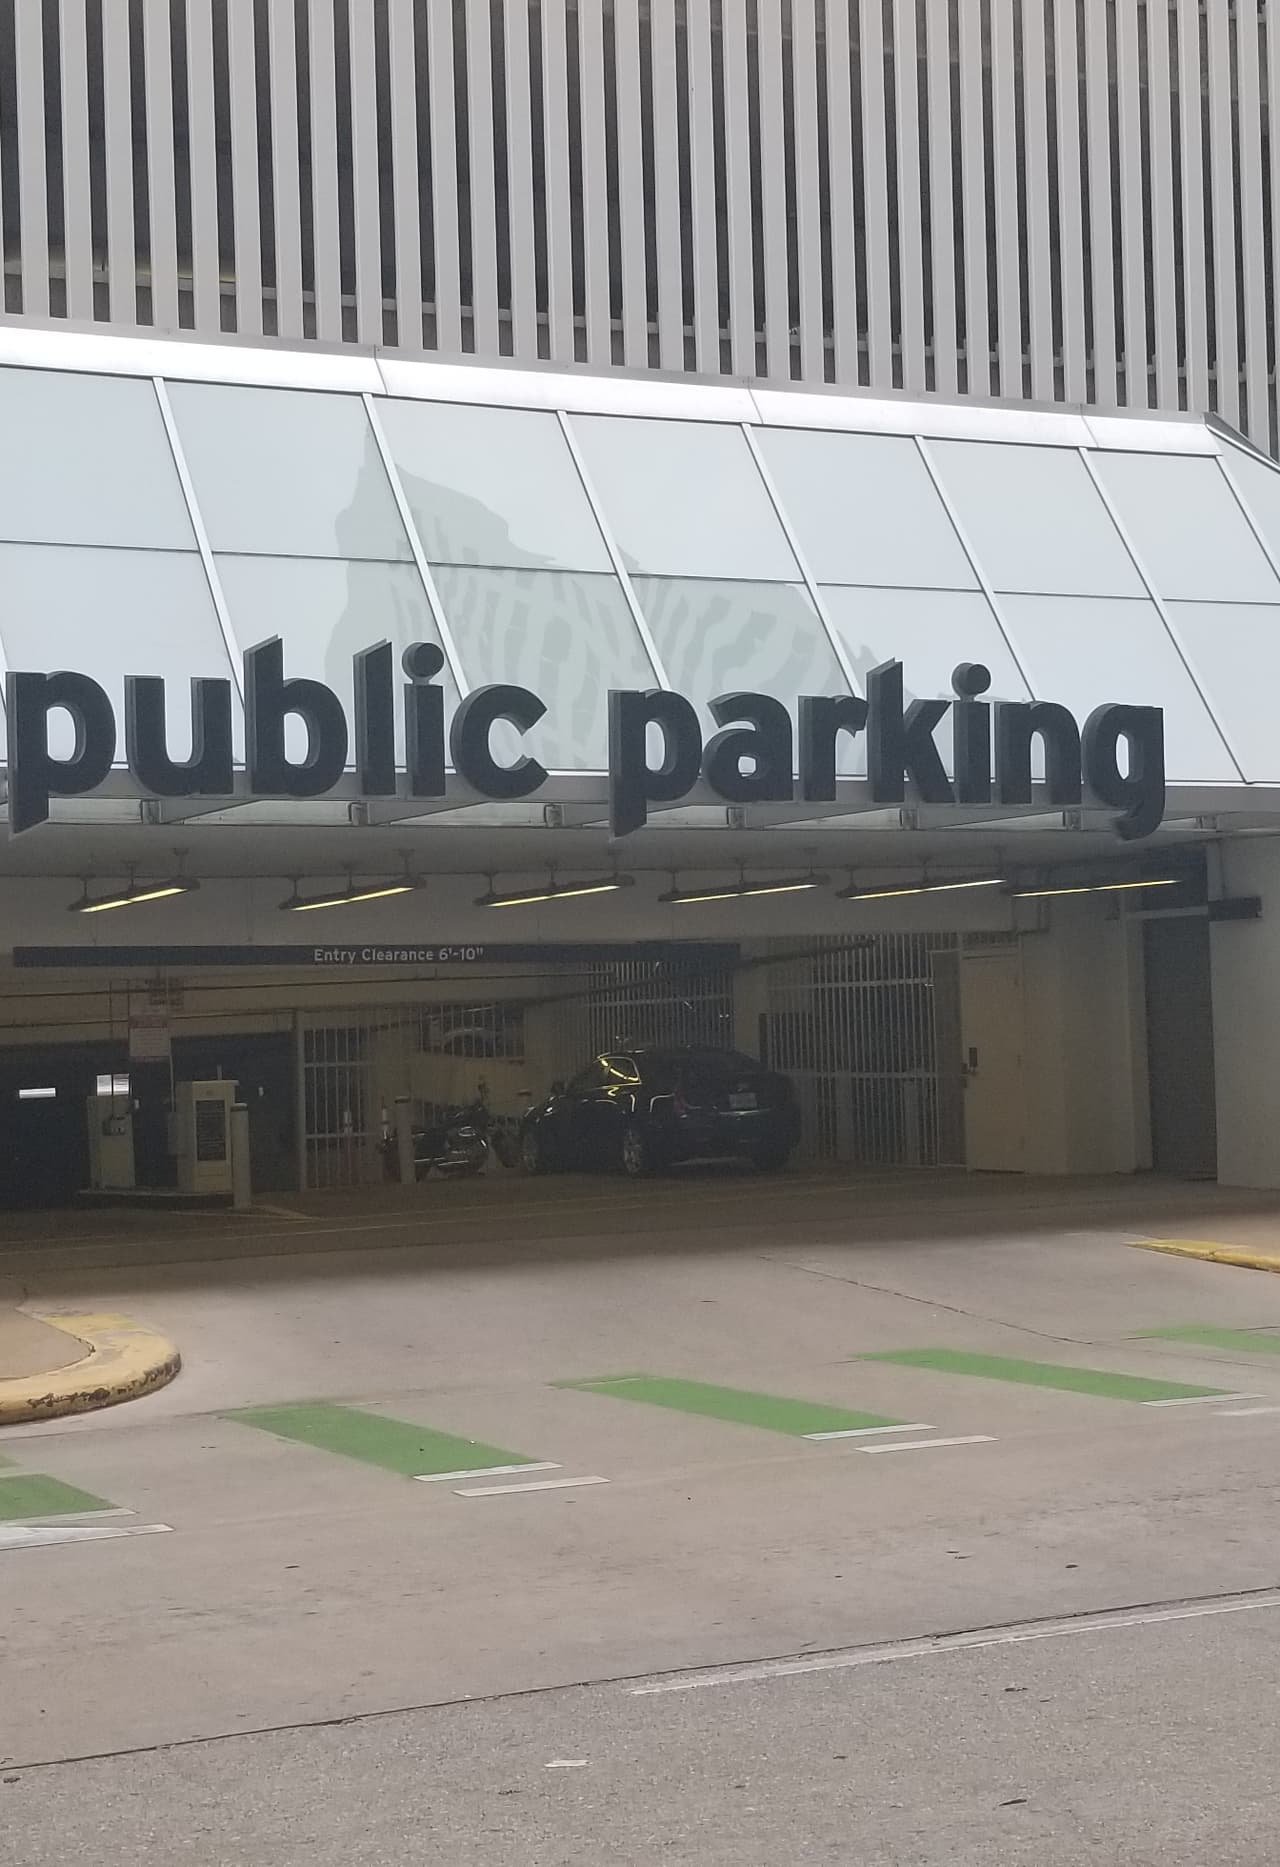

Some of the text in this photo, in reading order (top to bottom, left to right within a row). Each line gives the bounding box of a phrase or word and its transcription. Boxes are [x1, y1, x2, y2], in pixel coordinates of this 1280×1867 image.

[6, 634, 1165, 841] public parking
[314, 947, 484, 963] Entry Clearance 6'-10"
